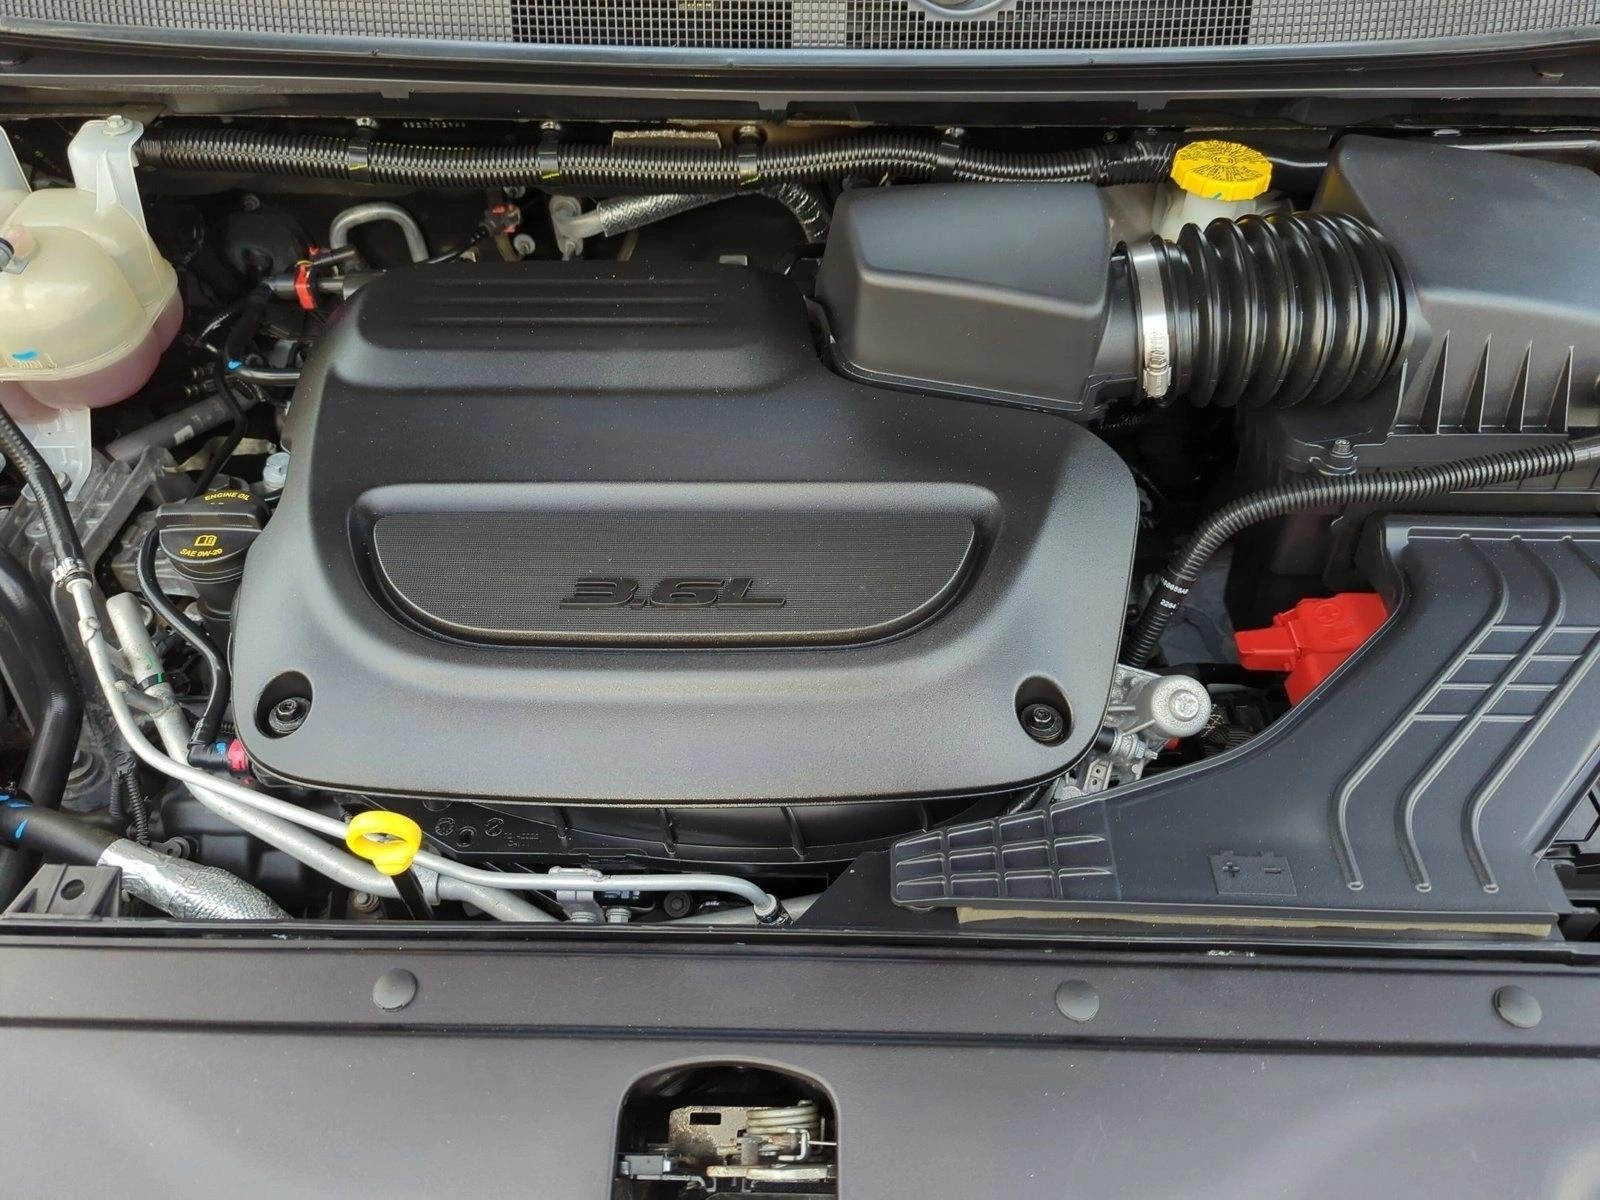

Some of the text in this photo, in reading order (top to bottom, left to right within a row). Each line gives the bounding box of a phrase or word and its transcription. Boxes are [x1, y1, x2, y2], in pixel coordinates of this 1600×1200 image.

[204, 492, 250, 501] ENGINE OIL
[180, 548, 223, 557] SAE 0W-20
[559, 577, 786, 609] 3.6L
